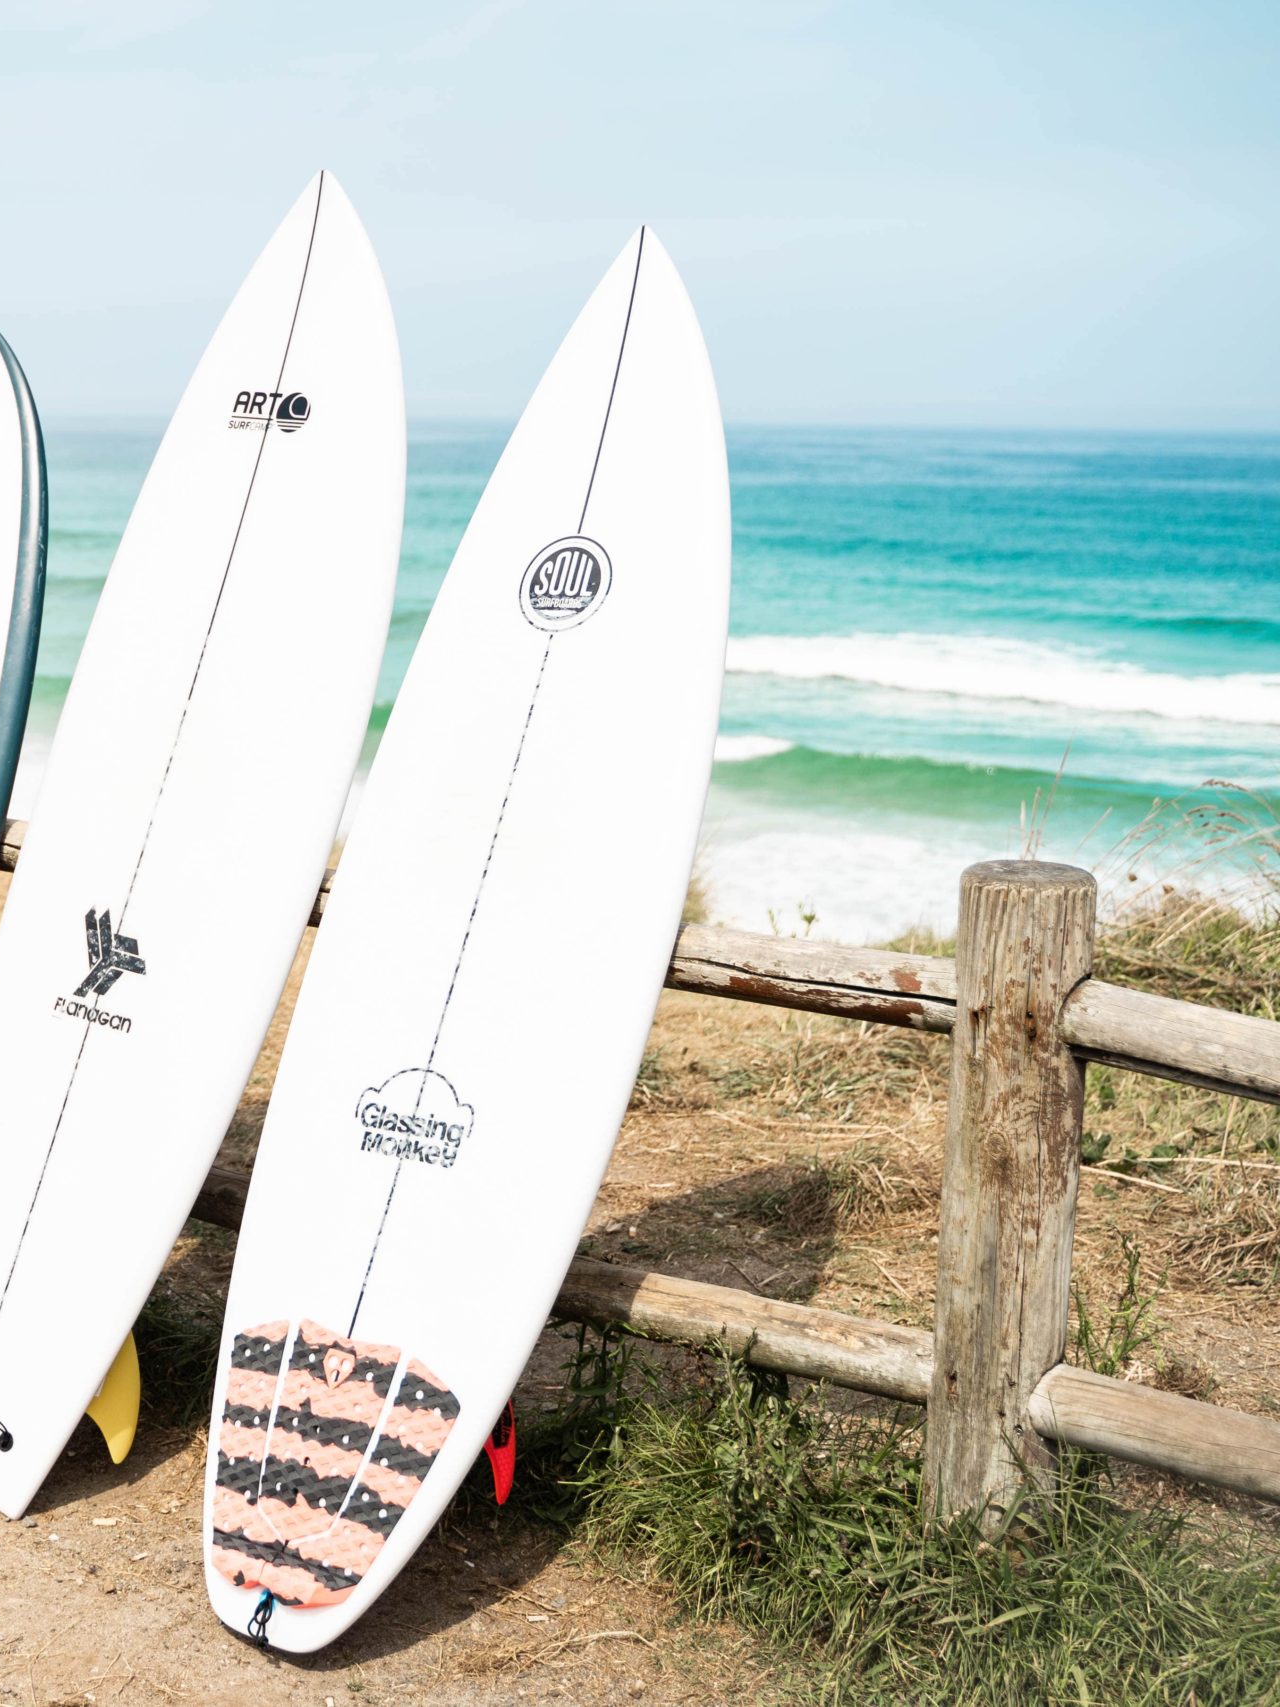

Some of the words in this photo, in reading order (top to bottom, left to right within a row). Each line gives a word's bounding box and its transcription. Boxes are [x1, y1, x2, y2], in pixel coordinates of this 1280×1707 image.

[233, 391, 283, 416] ART
[534, 550, 593, 597] SOUL
[361, 1103, 464, 1148] Glassing
[360, 1131, 458, 1168] Monkey
